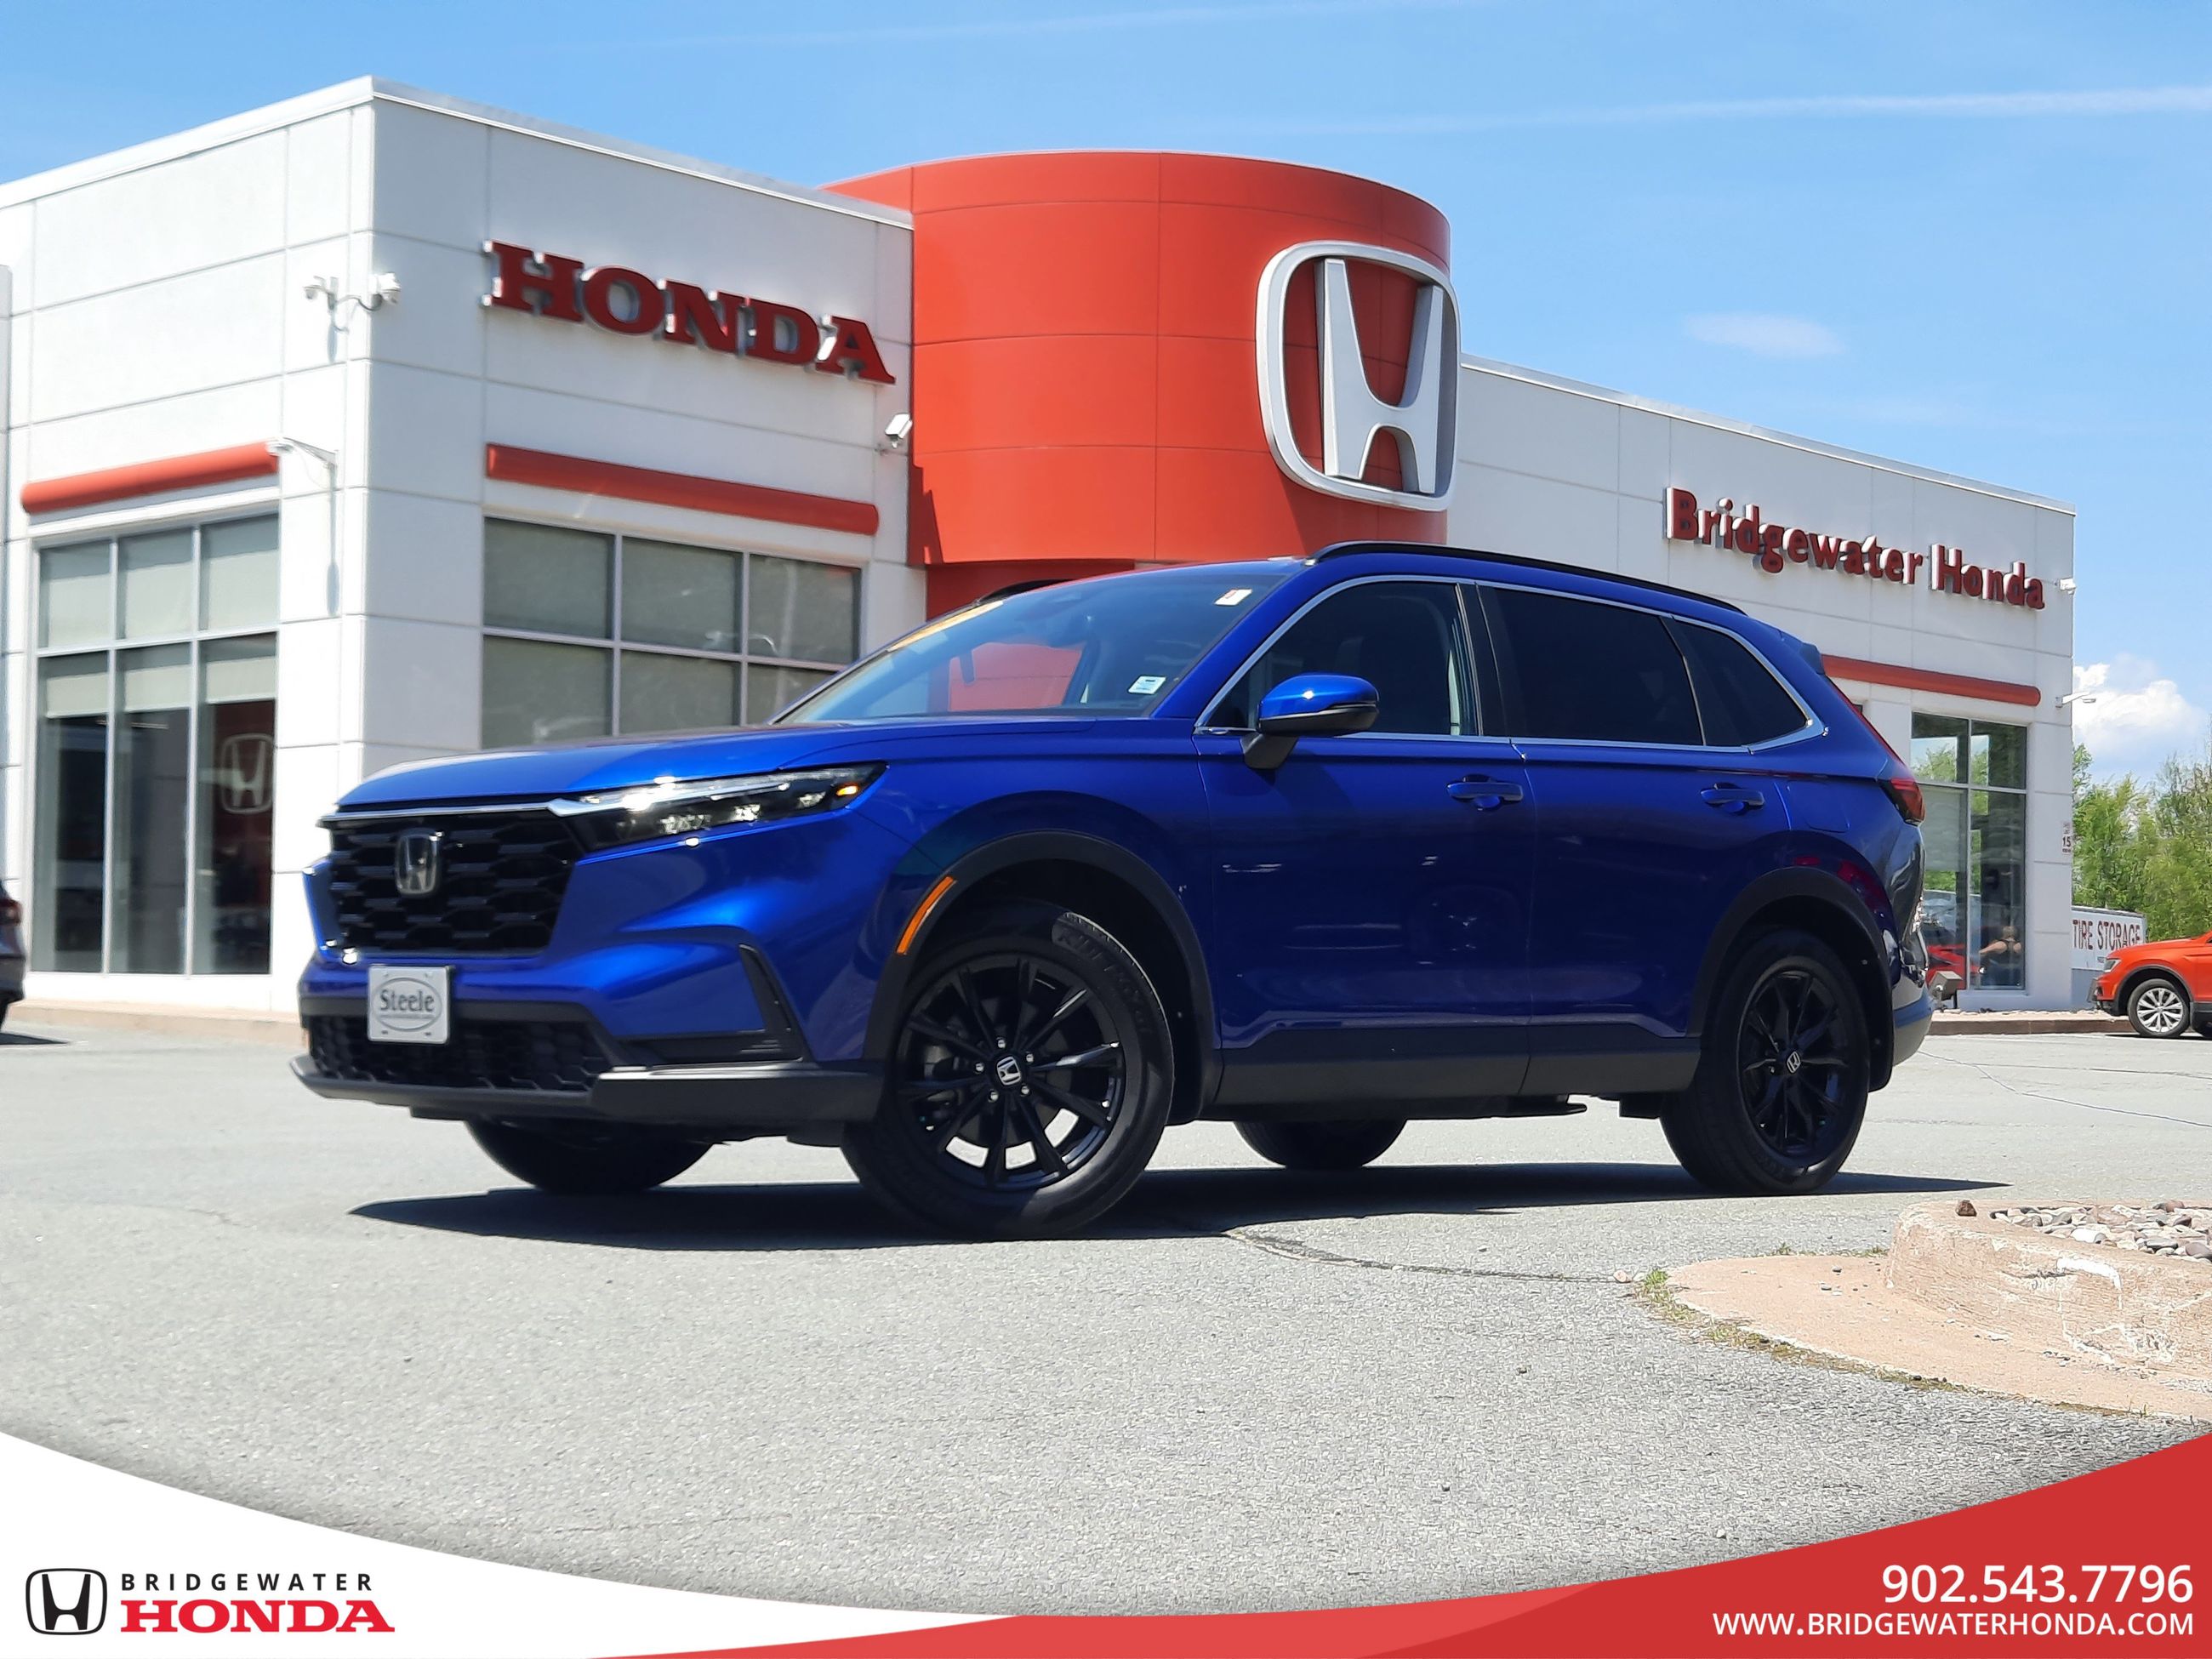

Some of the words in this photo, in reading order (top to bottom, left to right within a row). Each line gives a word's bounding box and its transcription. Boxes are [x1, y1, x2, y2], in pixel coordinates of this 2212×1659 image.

[482, 239, 896, 385] HONDA
[1667, 487, 1923, 585] Bridgewater
[1931, 543, 2045, 610] Honda
[2072, 920, 2093, 950] TIRE
[2097, 921, 2141, 950] STORAGE
[379, 989, 435, 1012] Steele
